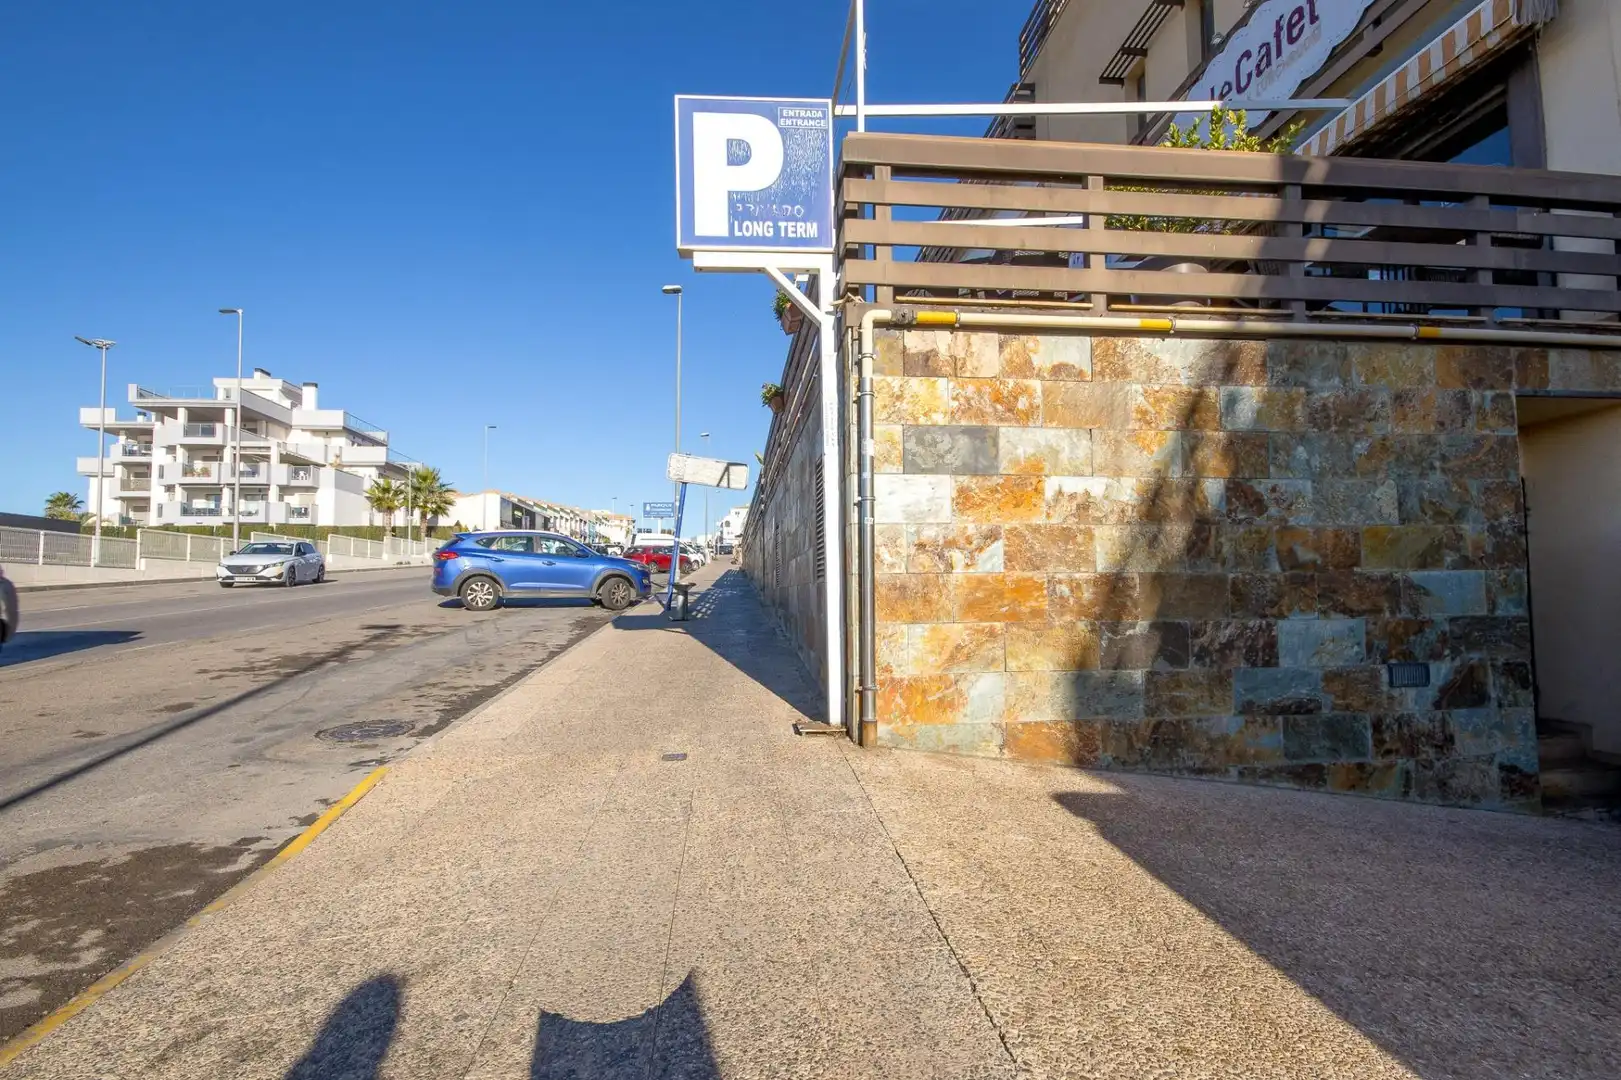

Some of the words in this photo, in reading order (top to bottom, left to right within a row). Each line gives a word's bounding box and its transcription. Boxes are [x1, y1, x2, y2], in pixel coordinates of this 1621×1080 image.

[782, 109, 823, 118] ENTRADA
[780, 118, 826, 127] ENTRANCE
[692, 112, 784, 237] P
[734, 220, 774, 237] LONG
[778, 221, 818, 238] TERM
